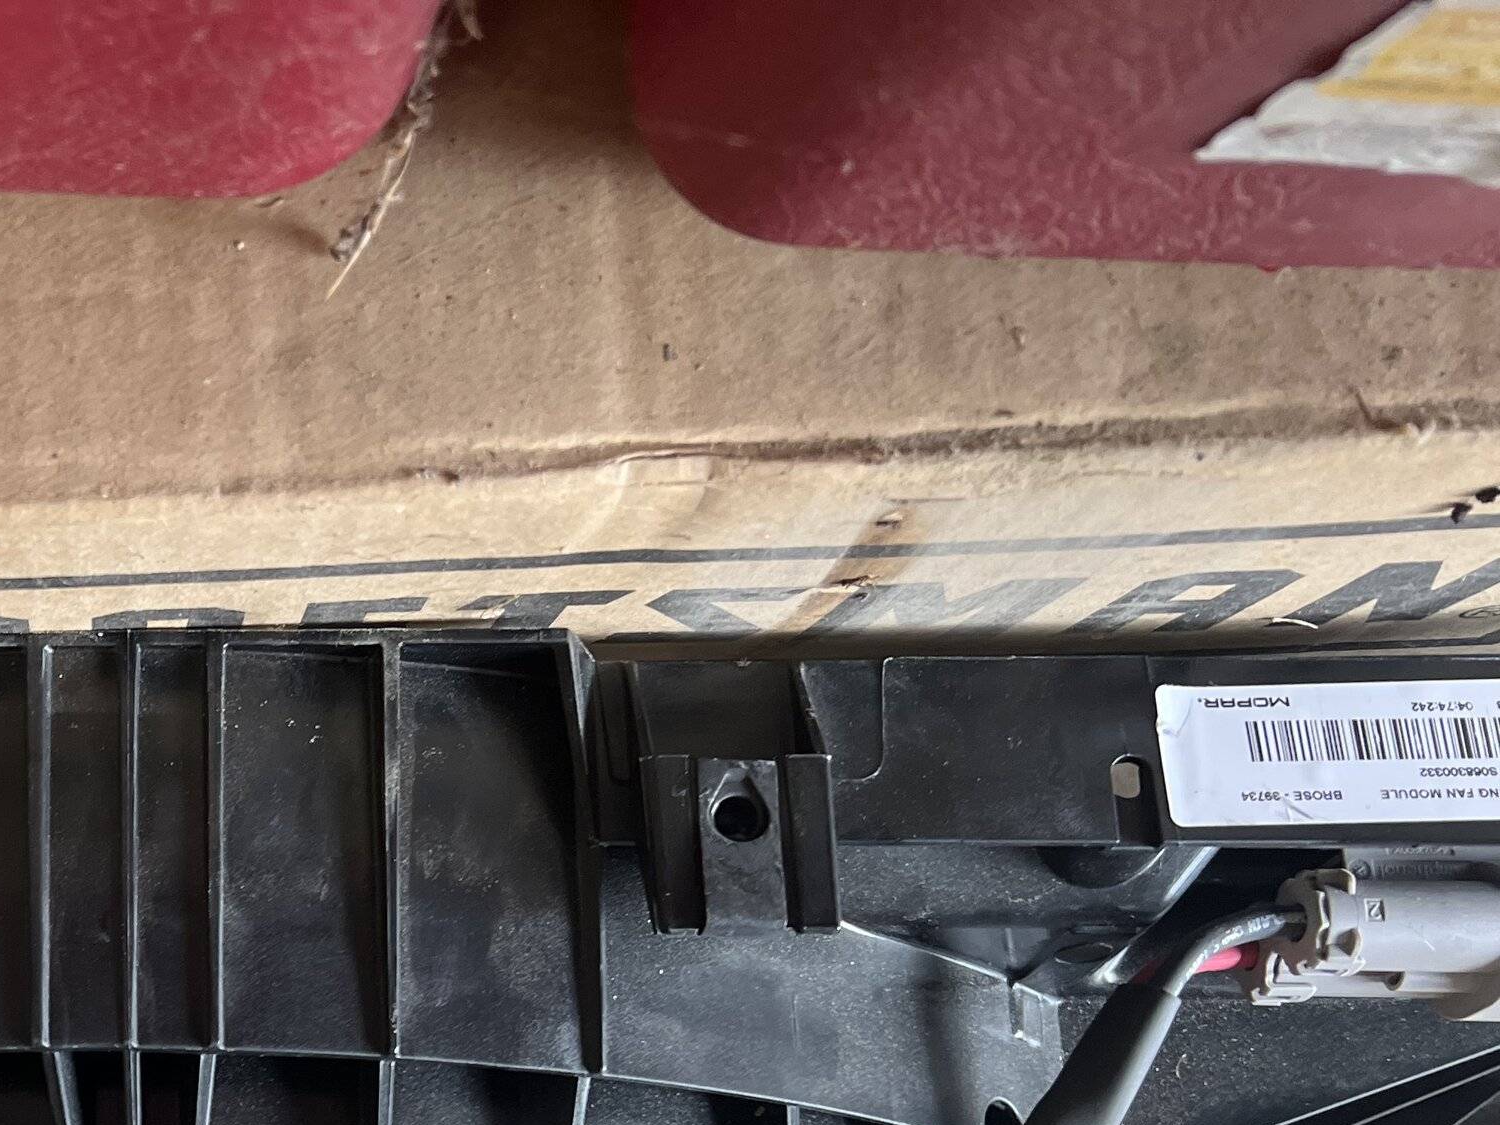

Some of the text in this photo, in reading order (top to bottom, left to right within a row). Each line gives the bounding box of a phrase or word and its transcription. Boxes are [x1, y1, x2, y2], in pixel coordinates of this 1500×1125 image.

[1241, 791, 1281, 801] 39734
[1294, 790, 1342, 801] BROSE
[1381, 788, 1442, 800] MODULE
[1447, 789, 1474, 799] FAN
